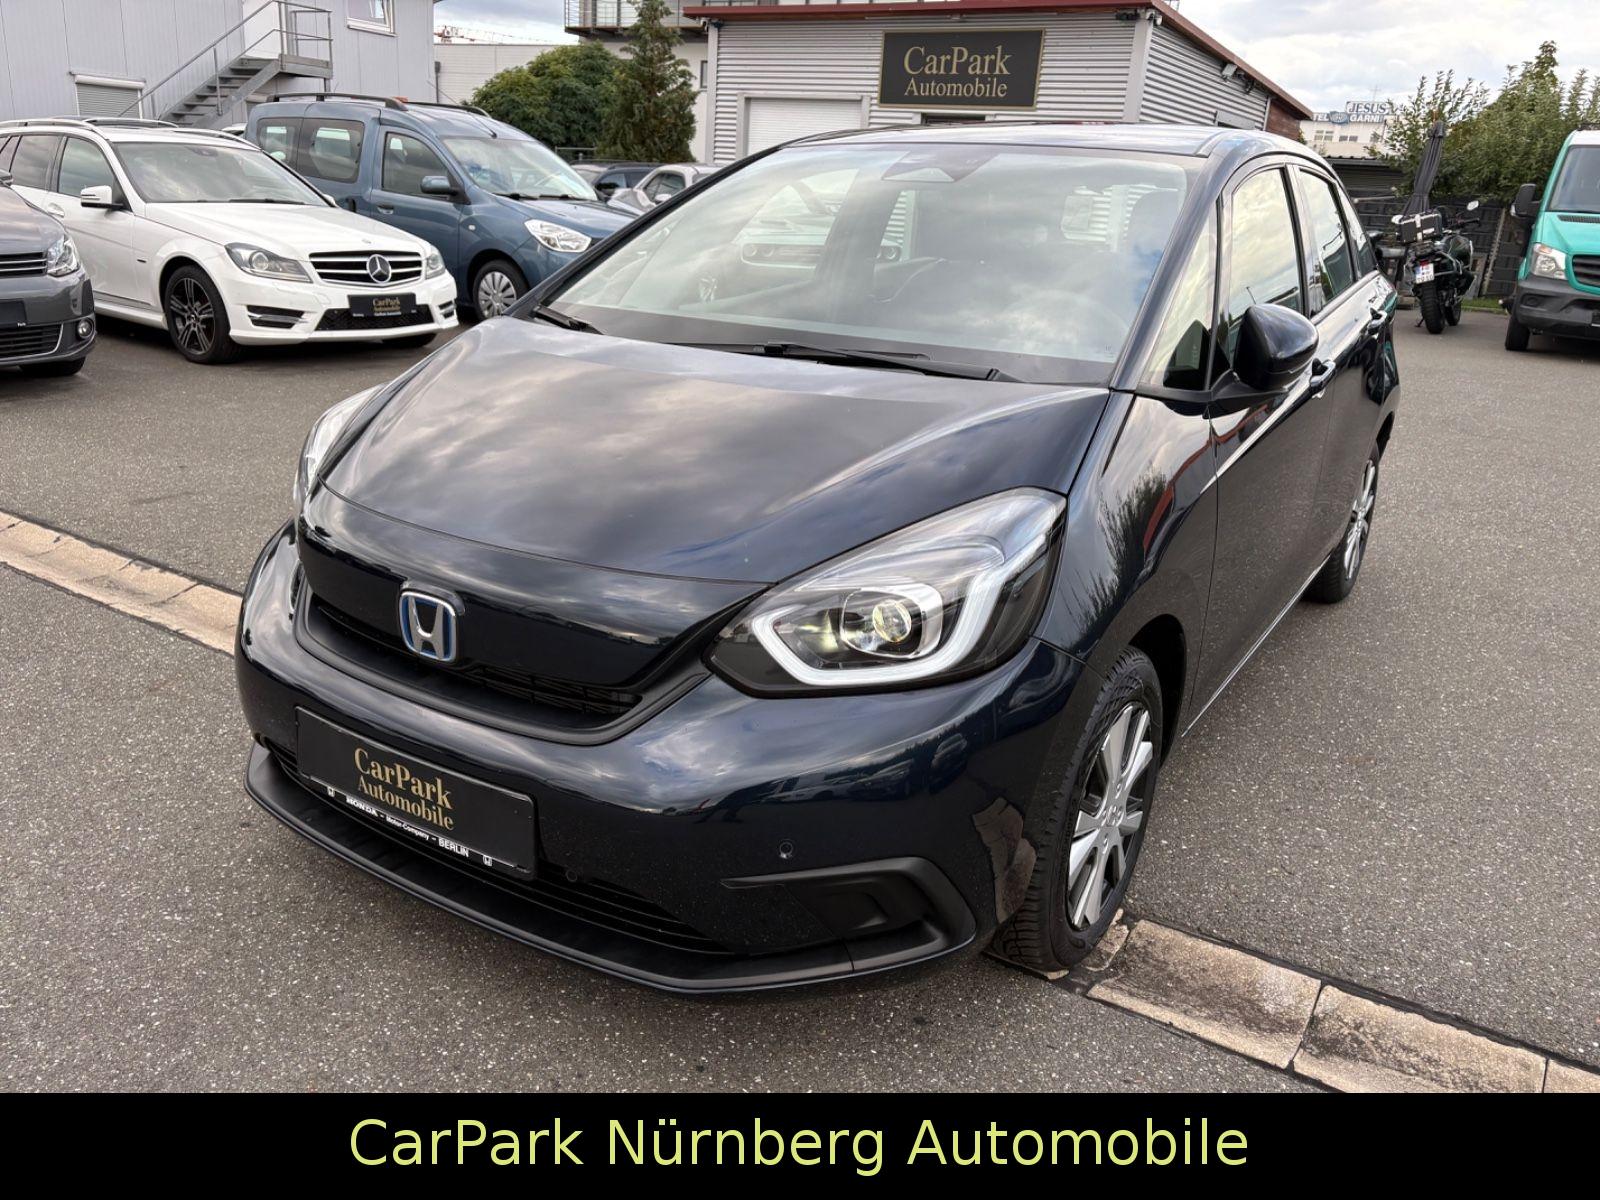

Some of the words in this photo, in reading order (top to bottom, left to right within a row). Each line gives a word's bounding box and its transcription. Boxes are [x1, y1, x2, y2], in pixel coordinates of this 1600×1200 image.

[904, 45, 1012, 75] CarPark
[904, 77, 1008, 98] Automobile
[1348, 102, 1387, 114] JESUS
[1350, 113, 1382, 123] GARNI
[354, 747, 453, 810] CarPark
[357, 775, 454, 831] Automobile
[346, 795, 378, 817] HONDA
[438, 836, 469, 858] BERLIN
